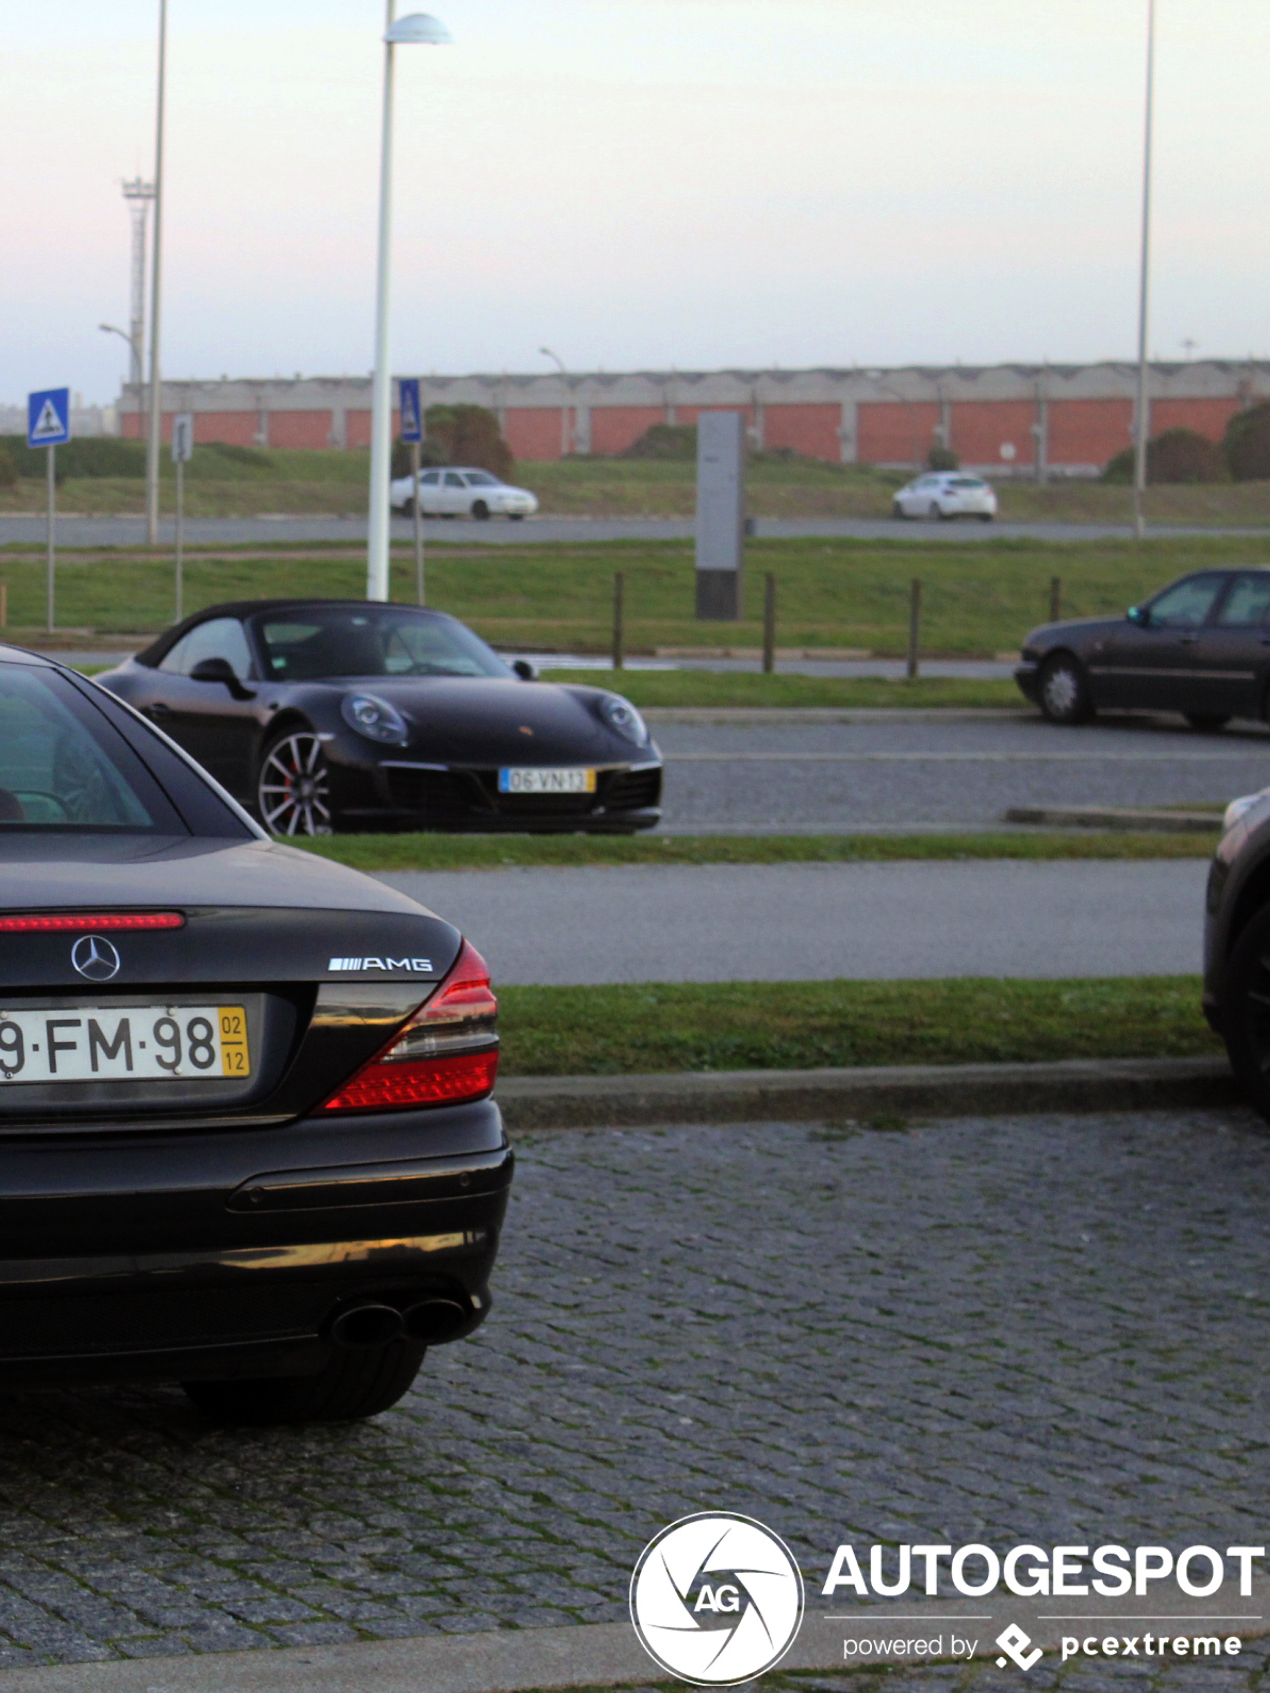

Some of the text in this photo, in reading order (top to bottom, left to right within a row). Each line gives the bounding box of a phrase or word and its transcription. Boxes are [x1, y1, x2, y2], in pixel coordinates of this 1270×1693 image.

[361, 957, 434, 972] AMG
[221, 1016, 242, 1034] 02
[225, 1052, 244, 1070] 12
